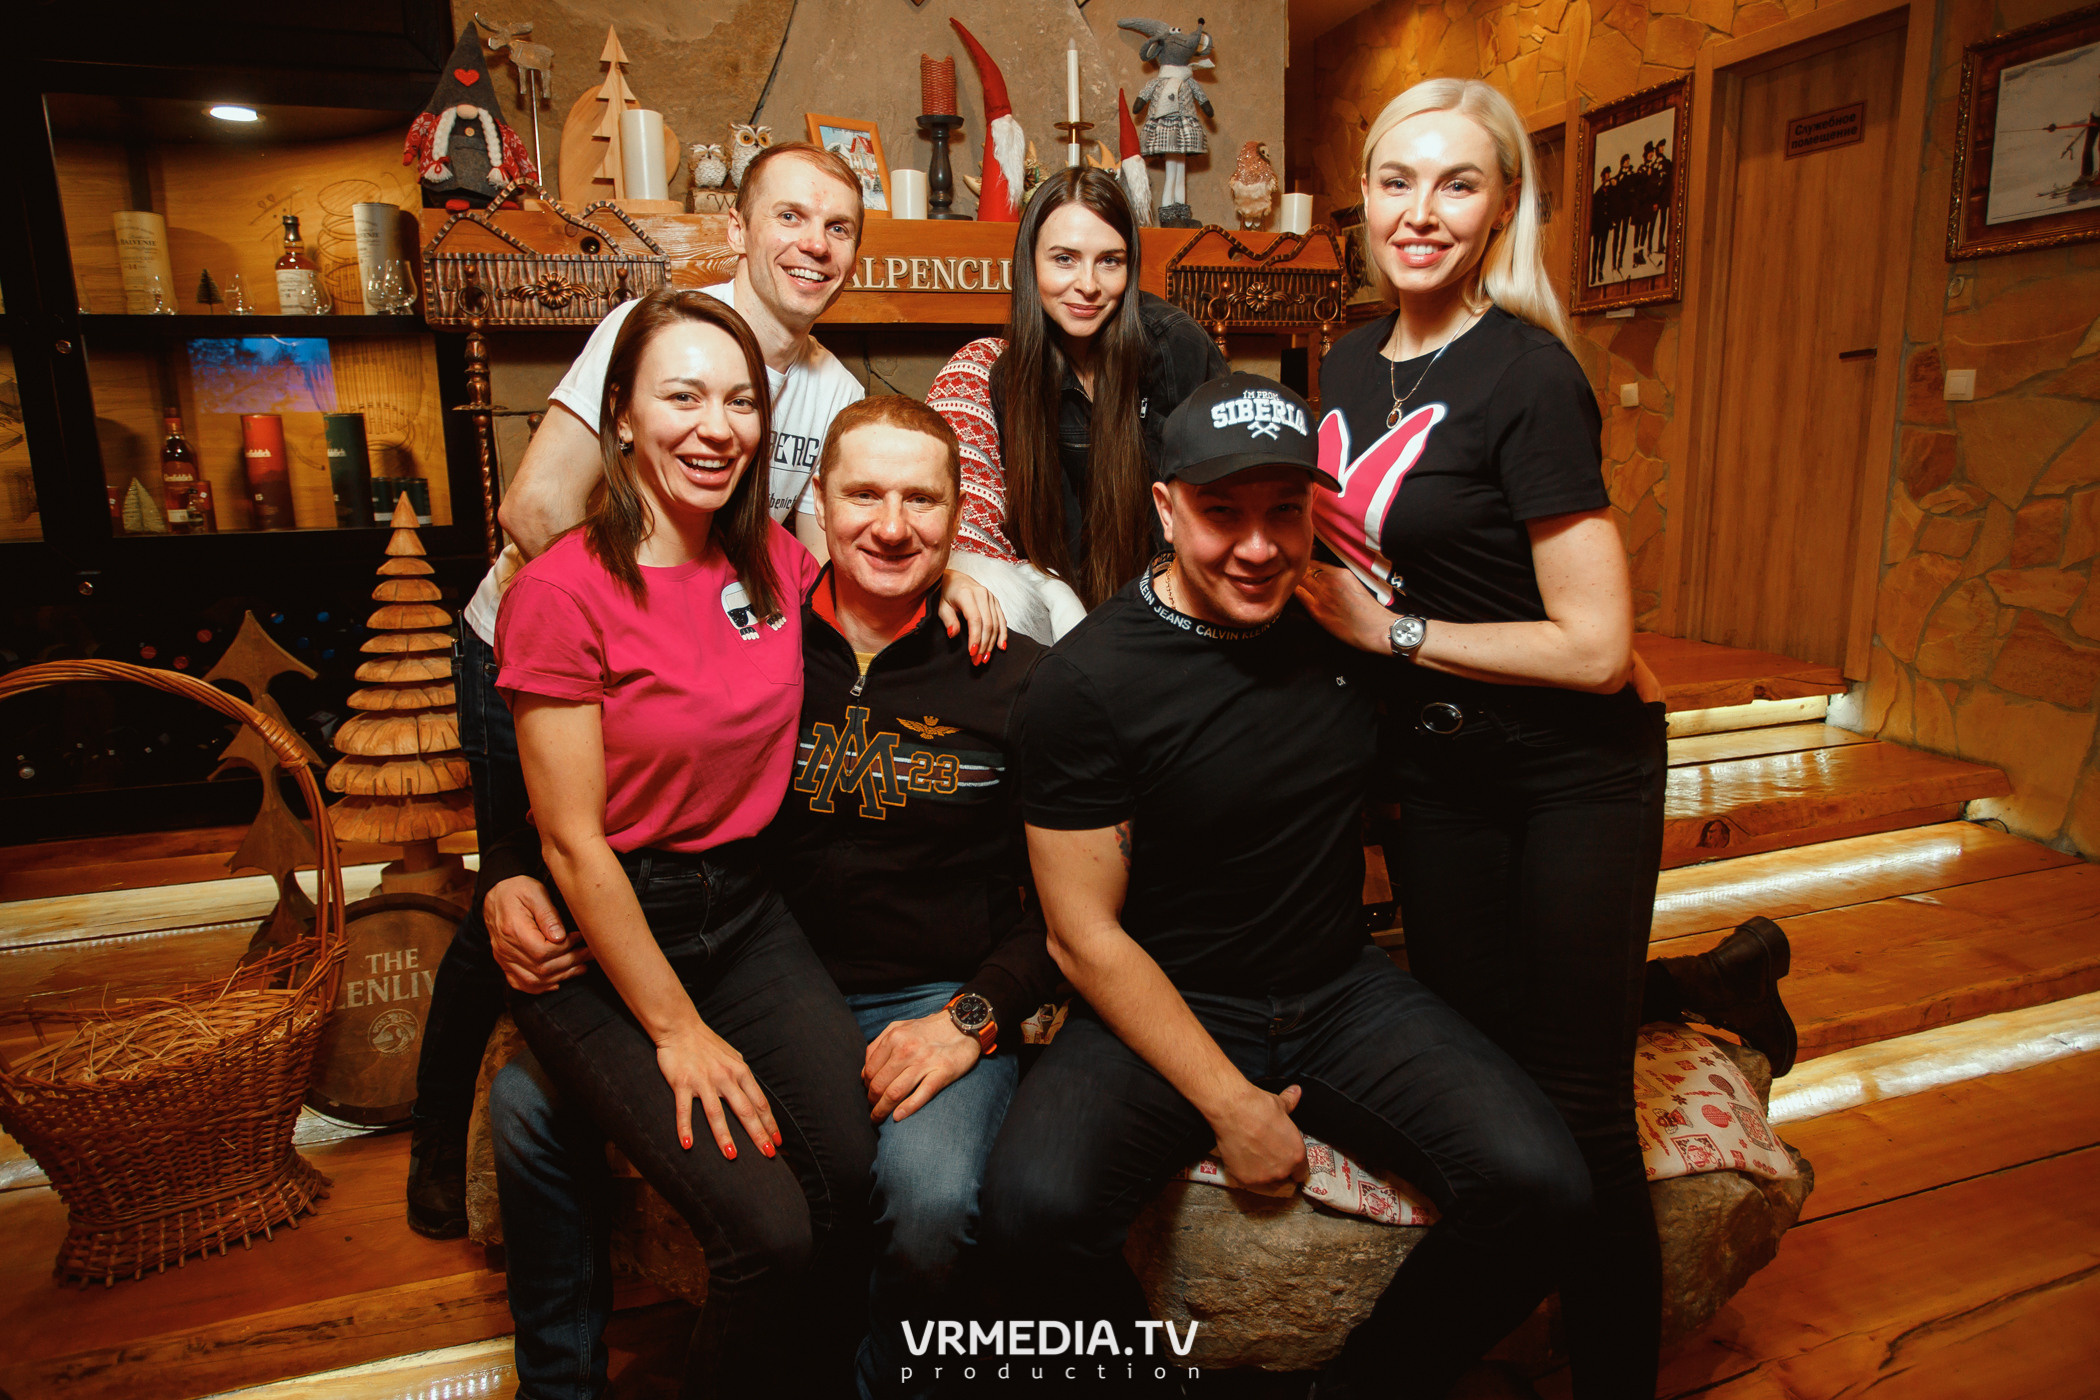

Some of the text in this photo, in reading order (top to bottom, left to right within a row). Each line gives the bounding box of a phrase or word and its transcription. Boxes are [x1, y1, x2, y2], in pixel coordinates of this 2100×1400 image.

[1791, 126, 1858, 149] помещение
[1795, 113, 1856, 136] Служебное
[1257, 391, 1280, 401] FROM
[1211, 398, 1308, 437] SIBERIA
[1153, 605, 1193, 630] JEANS
[1195, 624, 1239, 641] CALVIN
[907, 750, 960, 795] 23
[365, 948, 419, 975] THE
